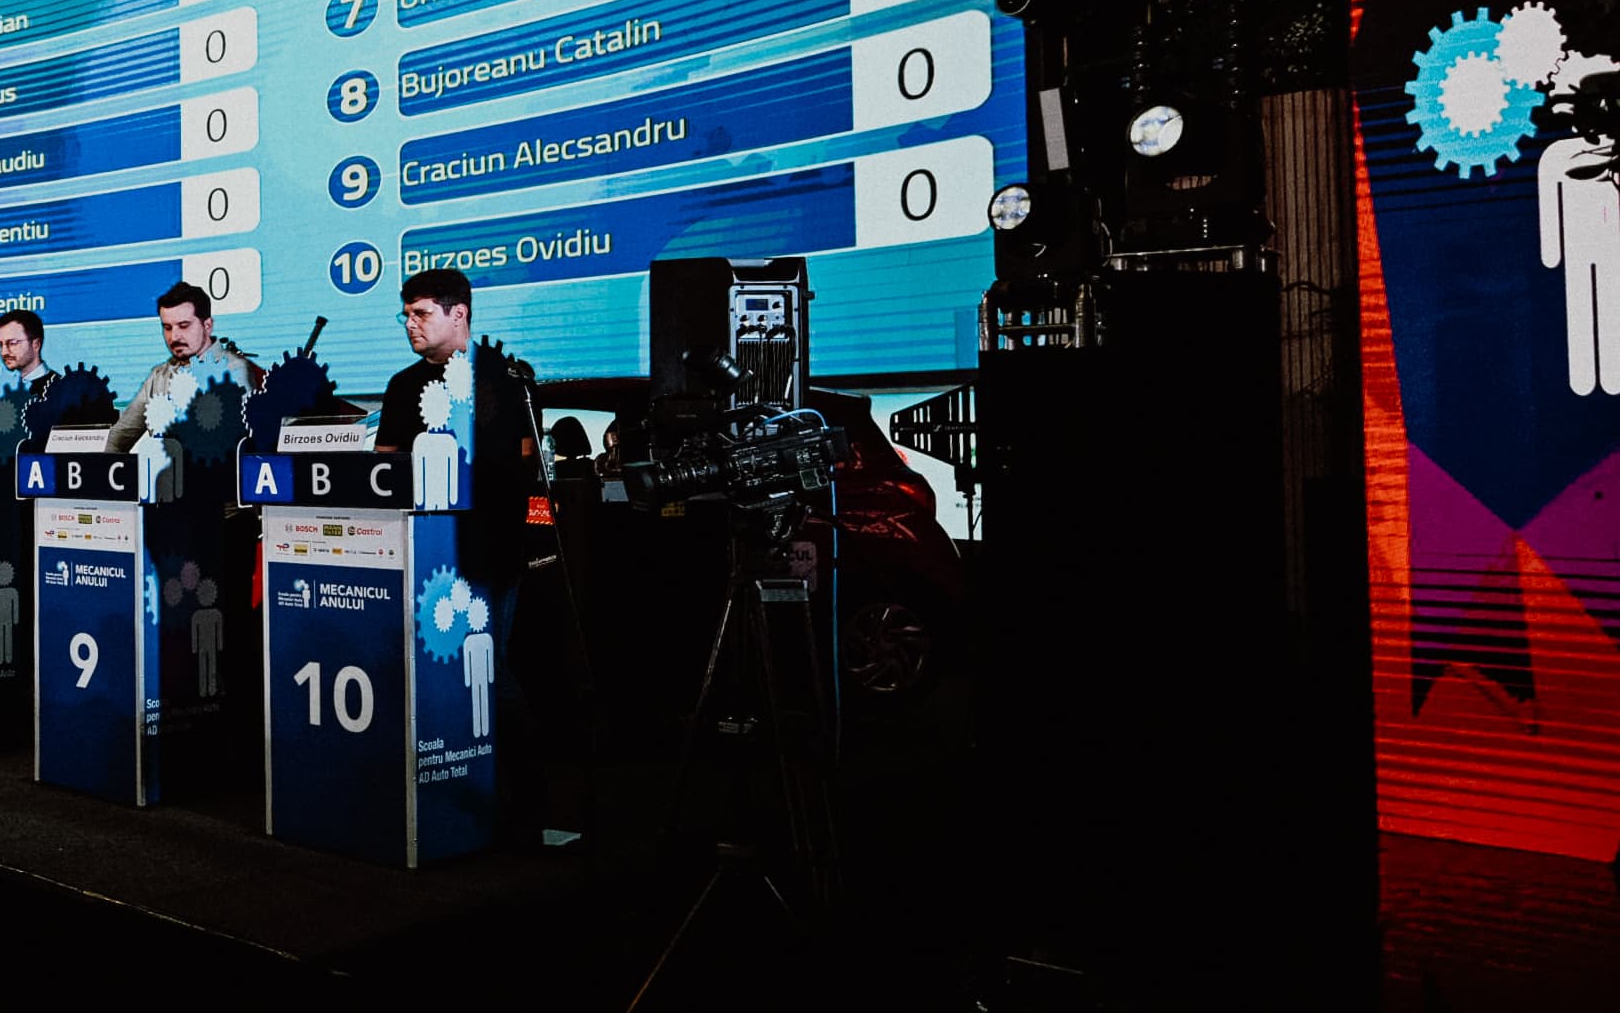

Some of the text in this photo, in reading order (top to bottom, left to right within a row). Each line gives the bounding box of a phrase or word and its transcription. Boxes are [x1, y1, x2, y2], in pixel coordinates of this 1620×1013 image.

[206, 30, 226, 63] 0
[340, 77, 368, 115] 8
[401, 47, 546, 98] Bujoreanu
[554, 19, 661, 64] Catalin
[206, 109, 227, 142] 0
[341, 47, 935, 201] 9 Craciun Alecsandru 0
[207, 188, 228, 221] 0
[333, 168, 937, 284] 10 Birzoes Ovidiu 0
[209, 267, 229, 300] 0
[283, 432, 360, 444] Birzoes Ovidiu
[27, 461, 125, 491] A B C
[255, 462, 393, 497] A B C
[75, 564, 126, 578] MECANICUL
[75, 576, 108, 588] ANULUI
[319, 583, 391, 600] MECANICUL
[319, 596, 365, 610] ANULUI
[69, 632, 99, 689] 9
[293, 661, 374, 733] 10
[418, 737, 444, 753] Scoala
[418, 742, 493, 770] pentru Mecanici Auto
[418, 763, 468, 785] AD Auto Total
